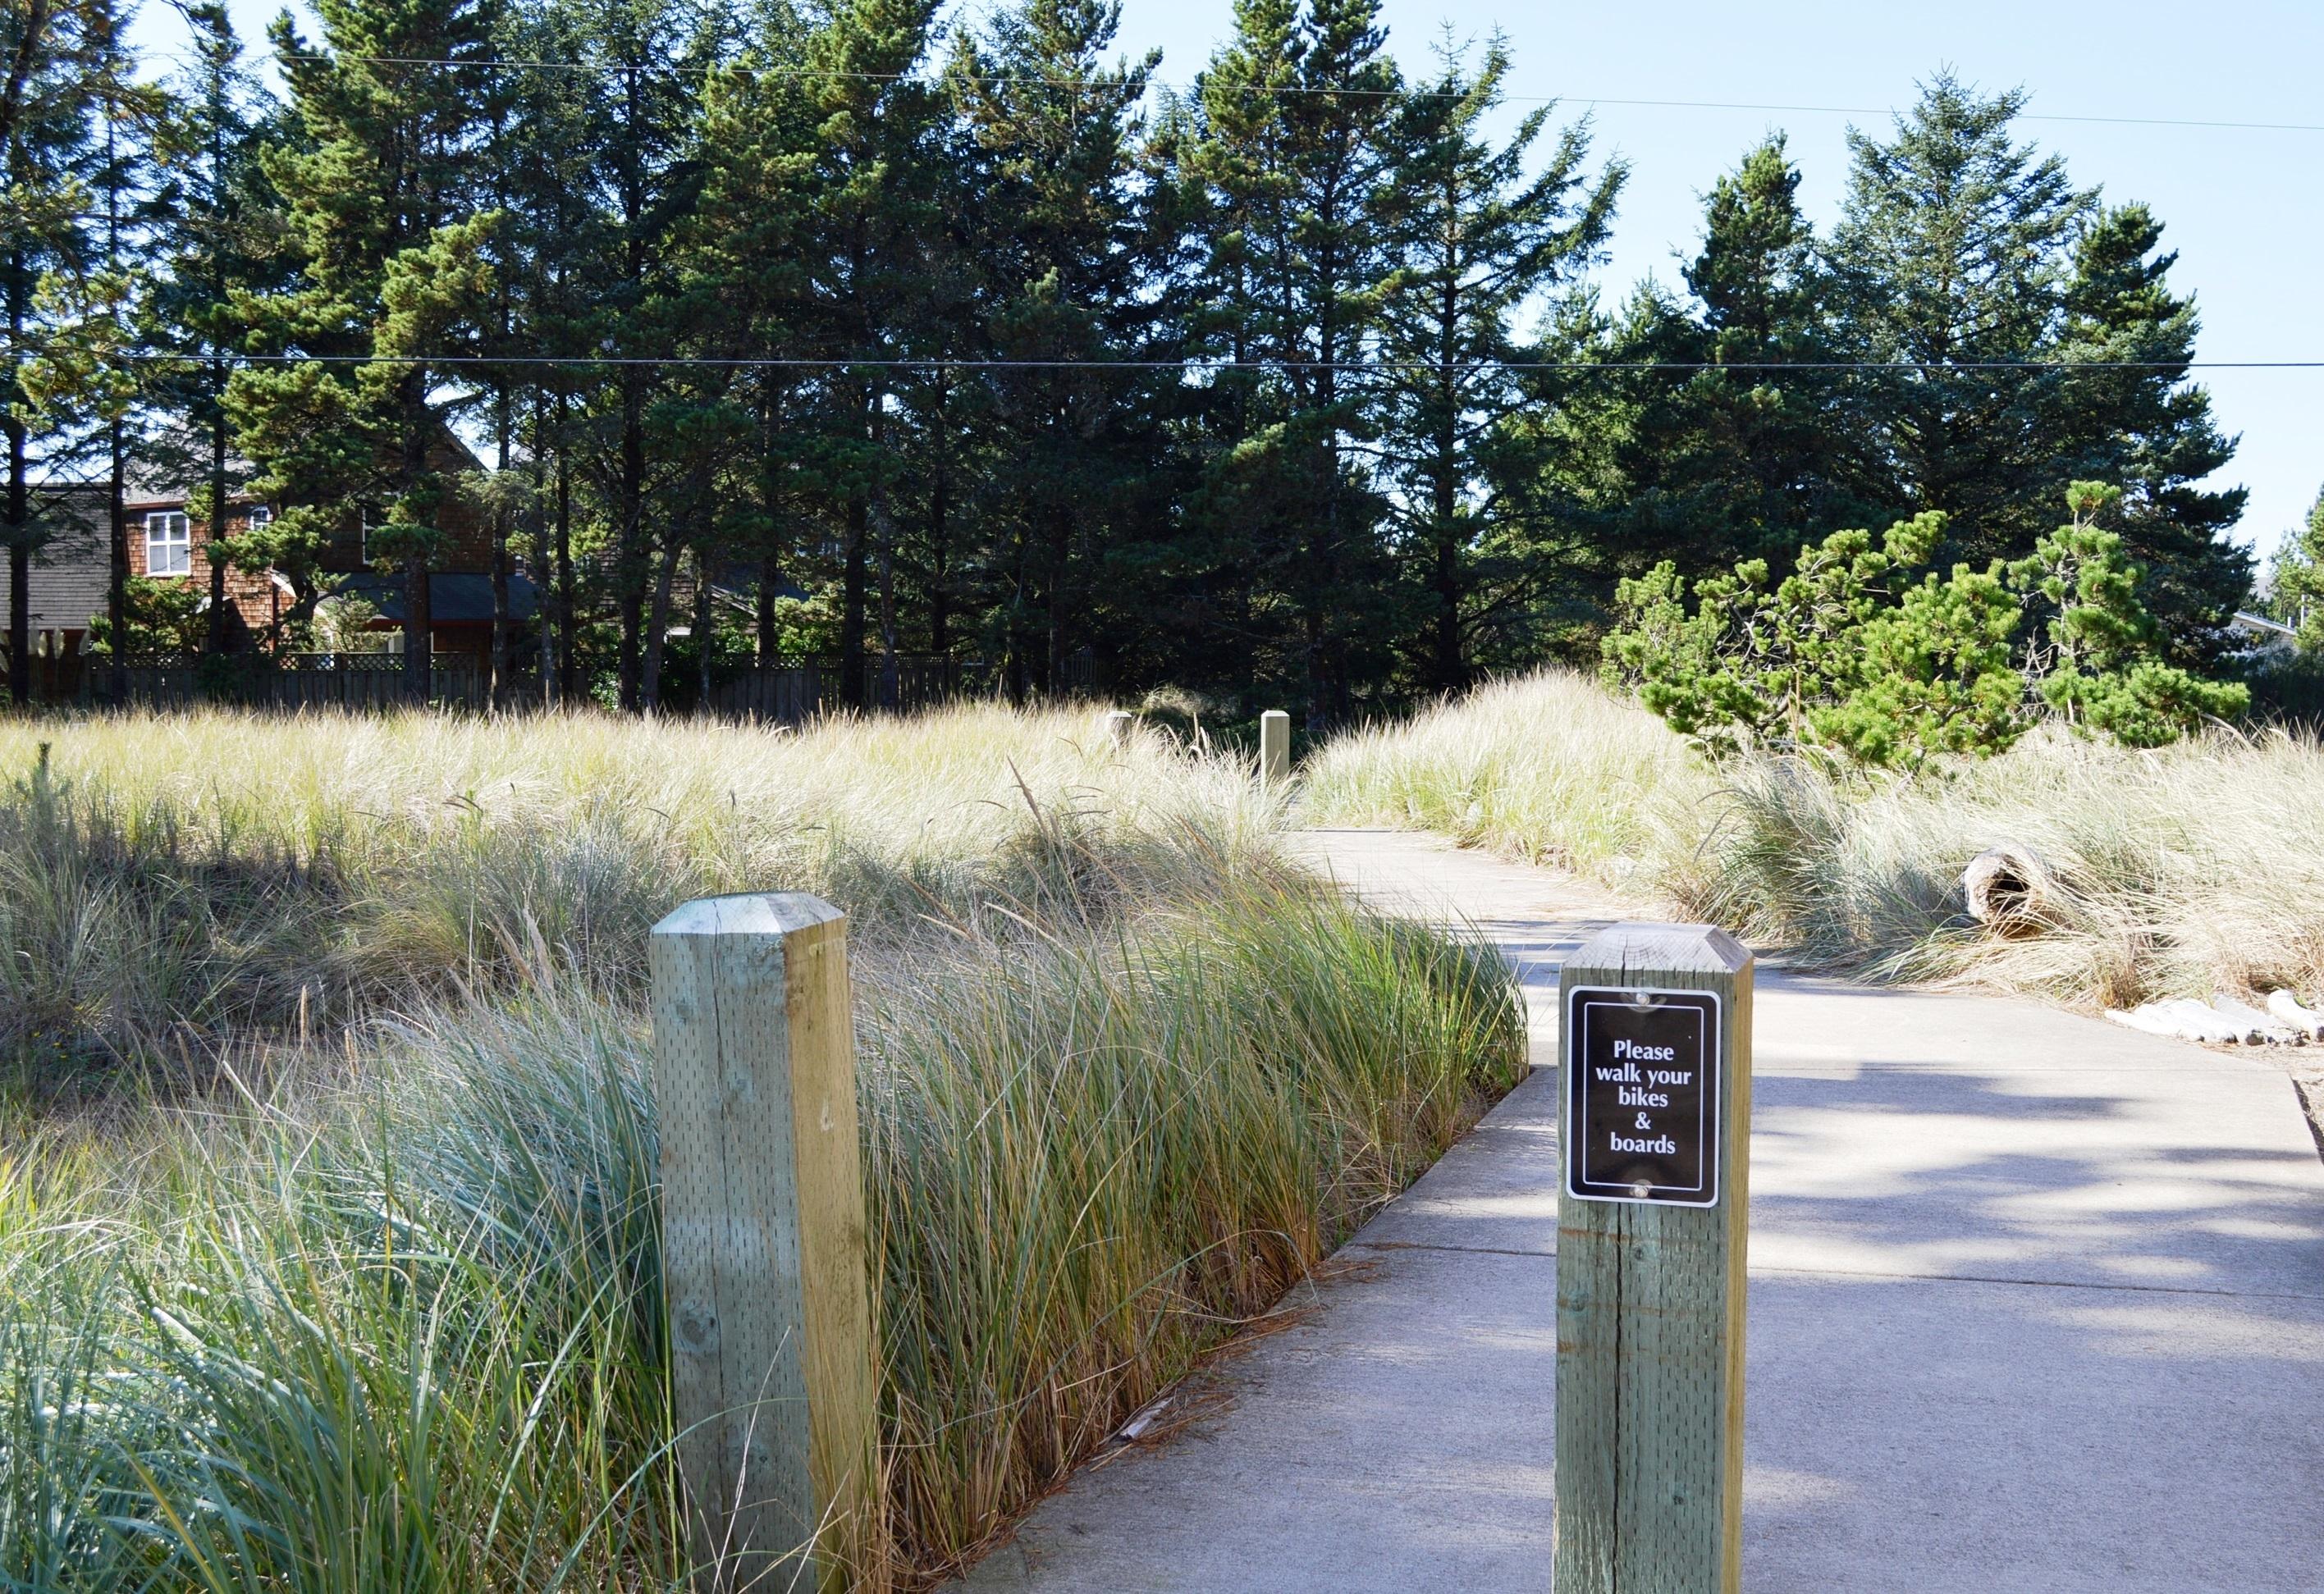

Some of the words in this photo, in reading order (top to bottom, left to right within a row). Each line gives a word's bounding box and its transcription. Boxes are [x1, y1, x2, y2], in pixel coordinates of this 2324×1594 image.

[1614, 1039, 1674, 1061] Please
[1596, 1063, 1640, 1082] walk
[1647, 1071, 1691, 1089] your
[1619, 1085, 1668, 1107] bikes
[1635, 1112, 1650, 1129] &
[1611, 1132, 1675, 1153] boards
